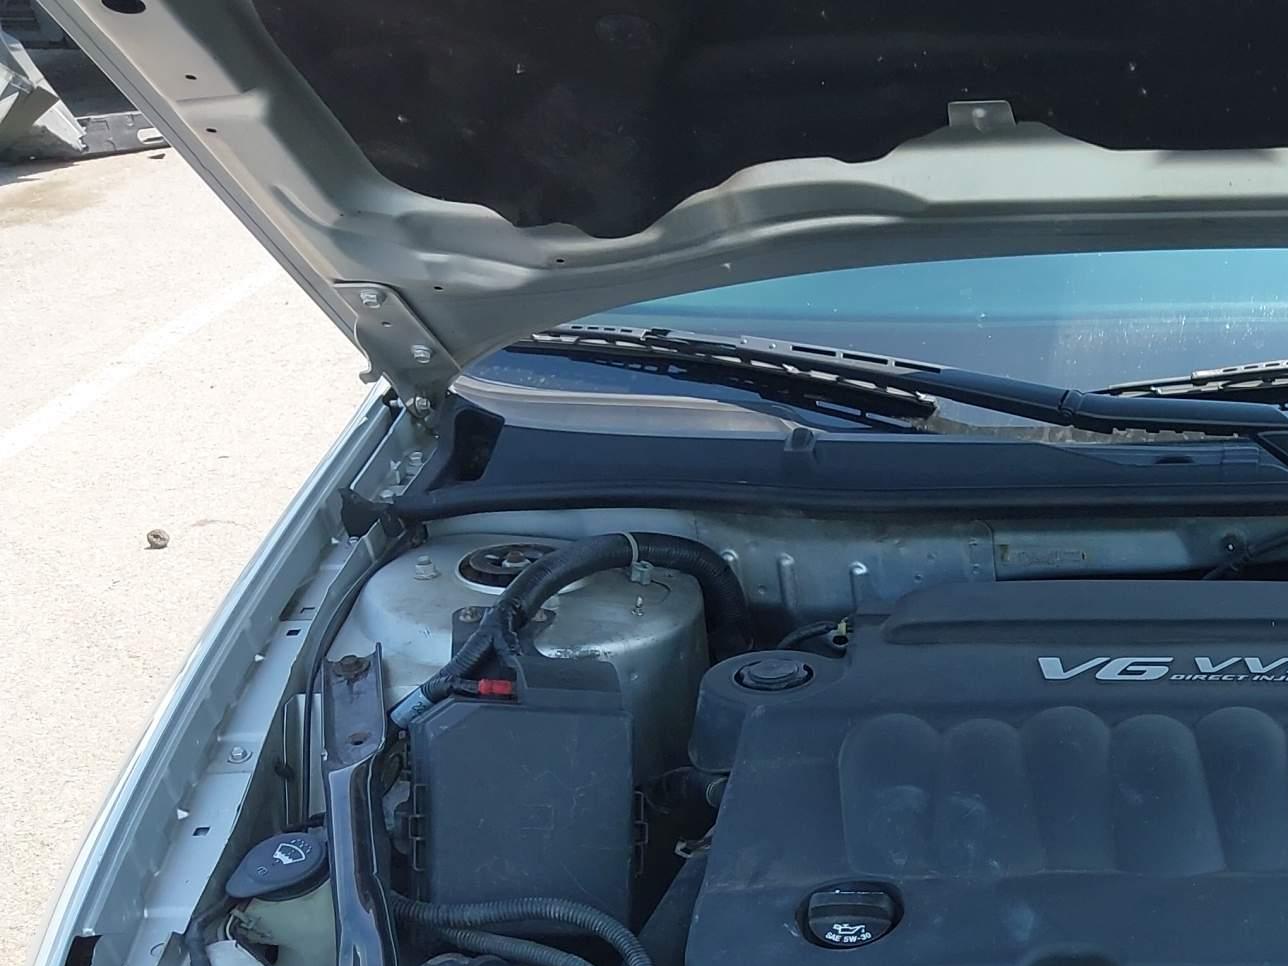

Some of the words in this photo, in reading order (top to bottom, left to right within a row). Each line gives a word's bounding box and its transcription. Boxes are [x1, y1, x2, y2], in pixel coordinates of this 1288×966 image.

[1037, 656, 1175, 681] V6
[1168, 674, 1249, 682] DIRECT
[825, 931, 842, 942] SAE
[843, 932, 872, 943] 5W-30
